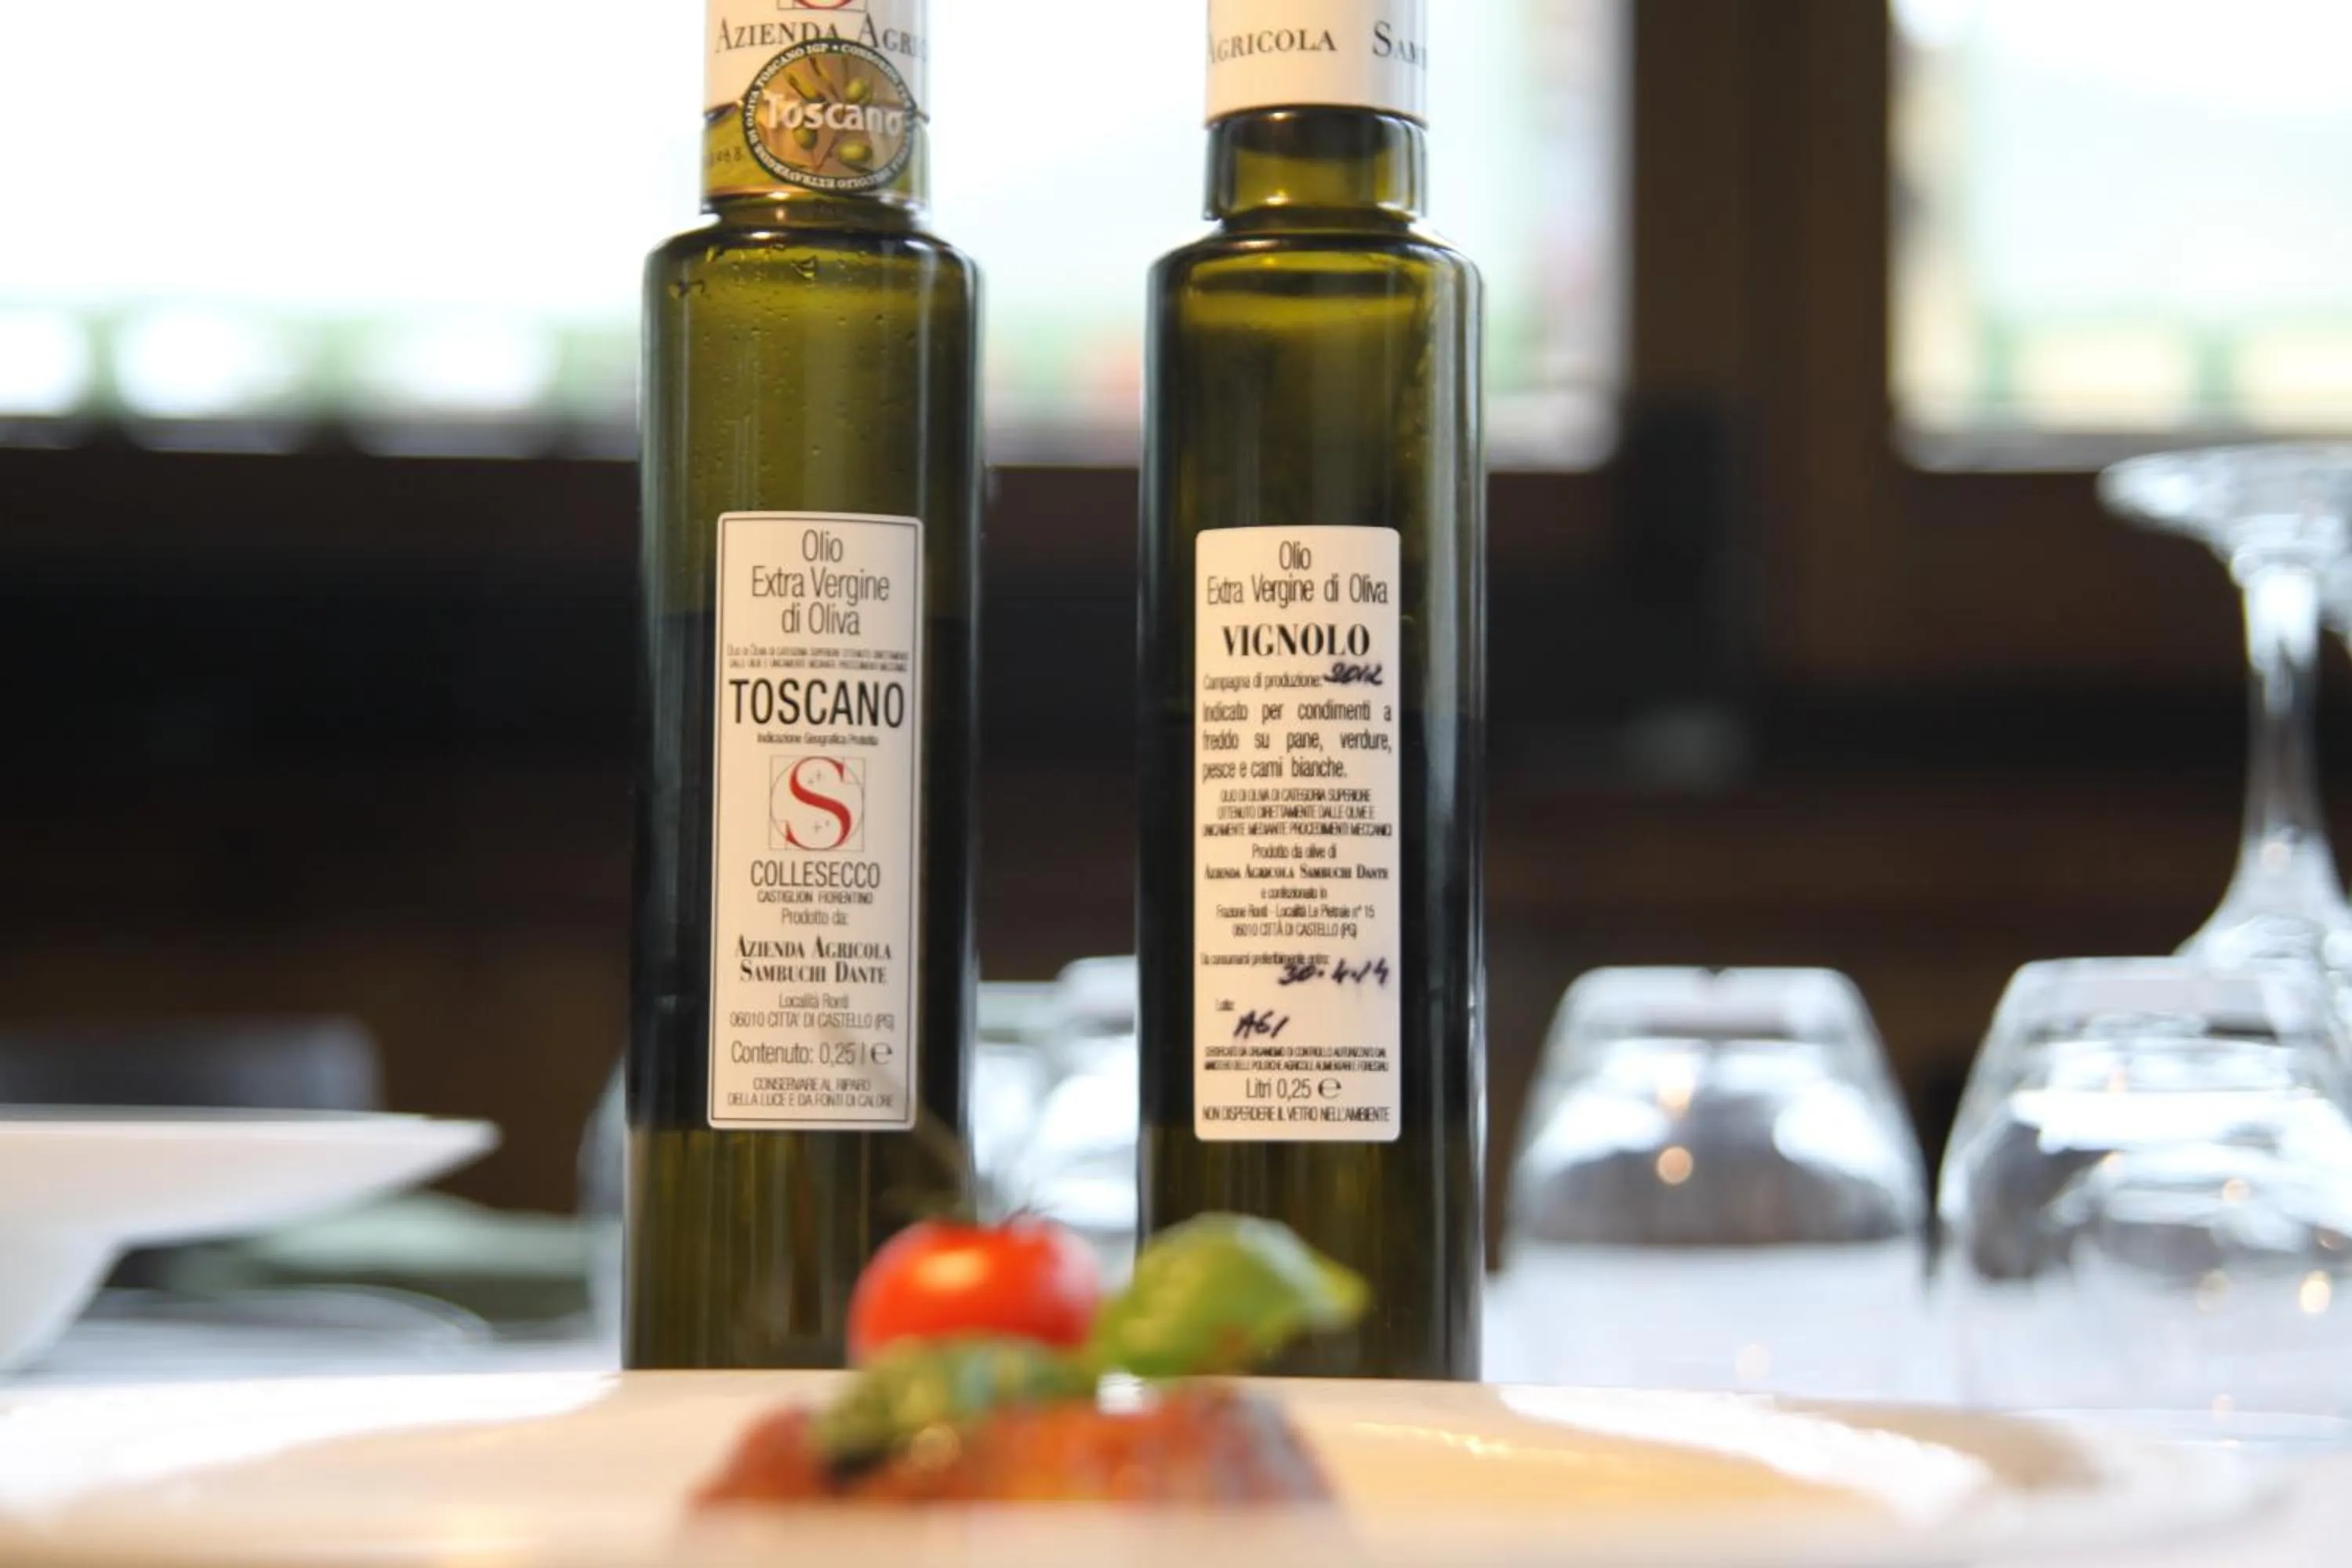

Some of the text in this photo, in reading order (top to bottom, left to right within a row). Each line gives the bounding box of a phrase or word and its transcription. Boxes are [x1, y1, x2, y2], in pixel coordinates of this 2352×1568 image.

[715, 16, 839, 53] AZIENDA
[760, 89, 902, 137] Toscano
[801, 529, 844, 563] Olio
[1279, 540, 1312, 570] Olio
[751, 565, 891, 607] Extra Vergine
[1207, 572, 1389, 609] Extra Vergine di Oliva
[782, 601, 861, 635] di Oliva
[1221, 622, 1371, 657] VIGNOLO
[1203, 672, 1323, 692] Campagna di produzione:
[1323, 662, 1384, 685] 2012
[729, 677, 905, 728] TOSCANO
[1203, 699, 1392, 725] Indicato per condimenti a
[1202, 728, 1392, 754] freddo su pane, verdure,
[1202, 755, 1348, 785] pesce e carni bianche.
[1252, 843, 1290, 858] Prodotto
[1290, 844, 1303, 858] da
[1327, 842, 1337, 859] di
[750, 859, 881, 888] COLLESECCO
[1204, 862, 1241, 879] AZIENDA
[1245, 863, 1294, 880] AGRICOLA
[1356, 863, 1389, 880] DANTE
[757, 890, 873, 904] CASTIGLION FIORENTINO
[781, 907, 829, 926] Prodotto
[1294, 923, 1339, 938] CASTELLO
[735, 933, 892, 960] AZIENDA AGRICOLA
[739, 959, 887, 985] SAMBUCHI DANTE
[779, 993, 850, 1010] Località Ronti
[729, 1011, 765, 1028] 06010
[803, 1012, 816, 1028] DI
[817, 1012, 873, 1029] CASTELLO
[874, 1012, 895, 1032] (PG)
[730, 1040, 815, 1065] Contenuto:
[818, 1041, 857, 1067] 0,25
[753, 1076, 872, 1092] CONSERVARE AL RIPARO
[1245, 1078, 1272, 1098] Litri
[1276, 1078, 1312, 1102] 0,25
[727, 1091, 895, 1108] DELLA LUCE E DA FONTI DI CALORE
[1203, 1105, 1391, 1122] NON DISPERDERE IL VETRO NELL'AMBIENTE
